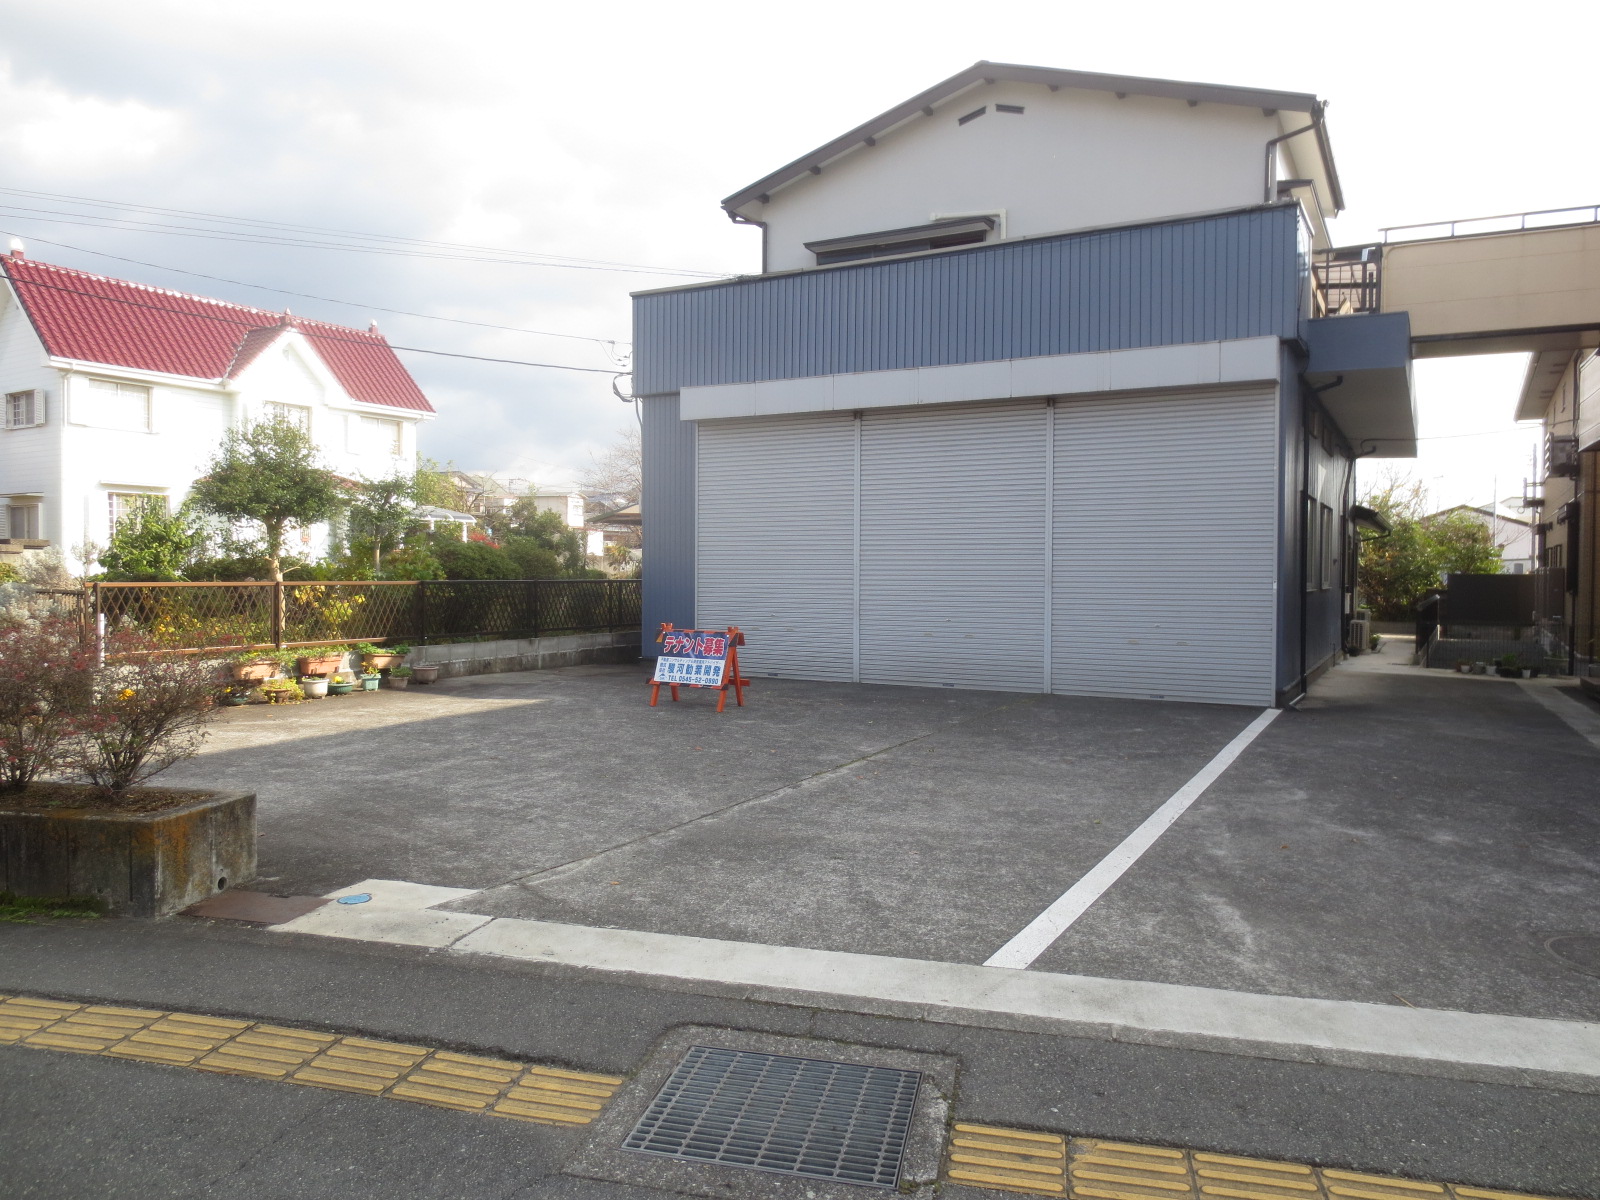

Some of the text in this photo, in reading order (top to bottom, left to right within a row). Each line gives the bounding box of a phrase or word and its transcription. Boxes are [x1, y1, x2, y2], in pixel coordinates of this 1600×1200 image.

[664, 636, 725, 656] テナント募集
